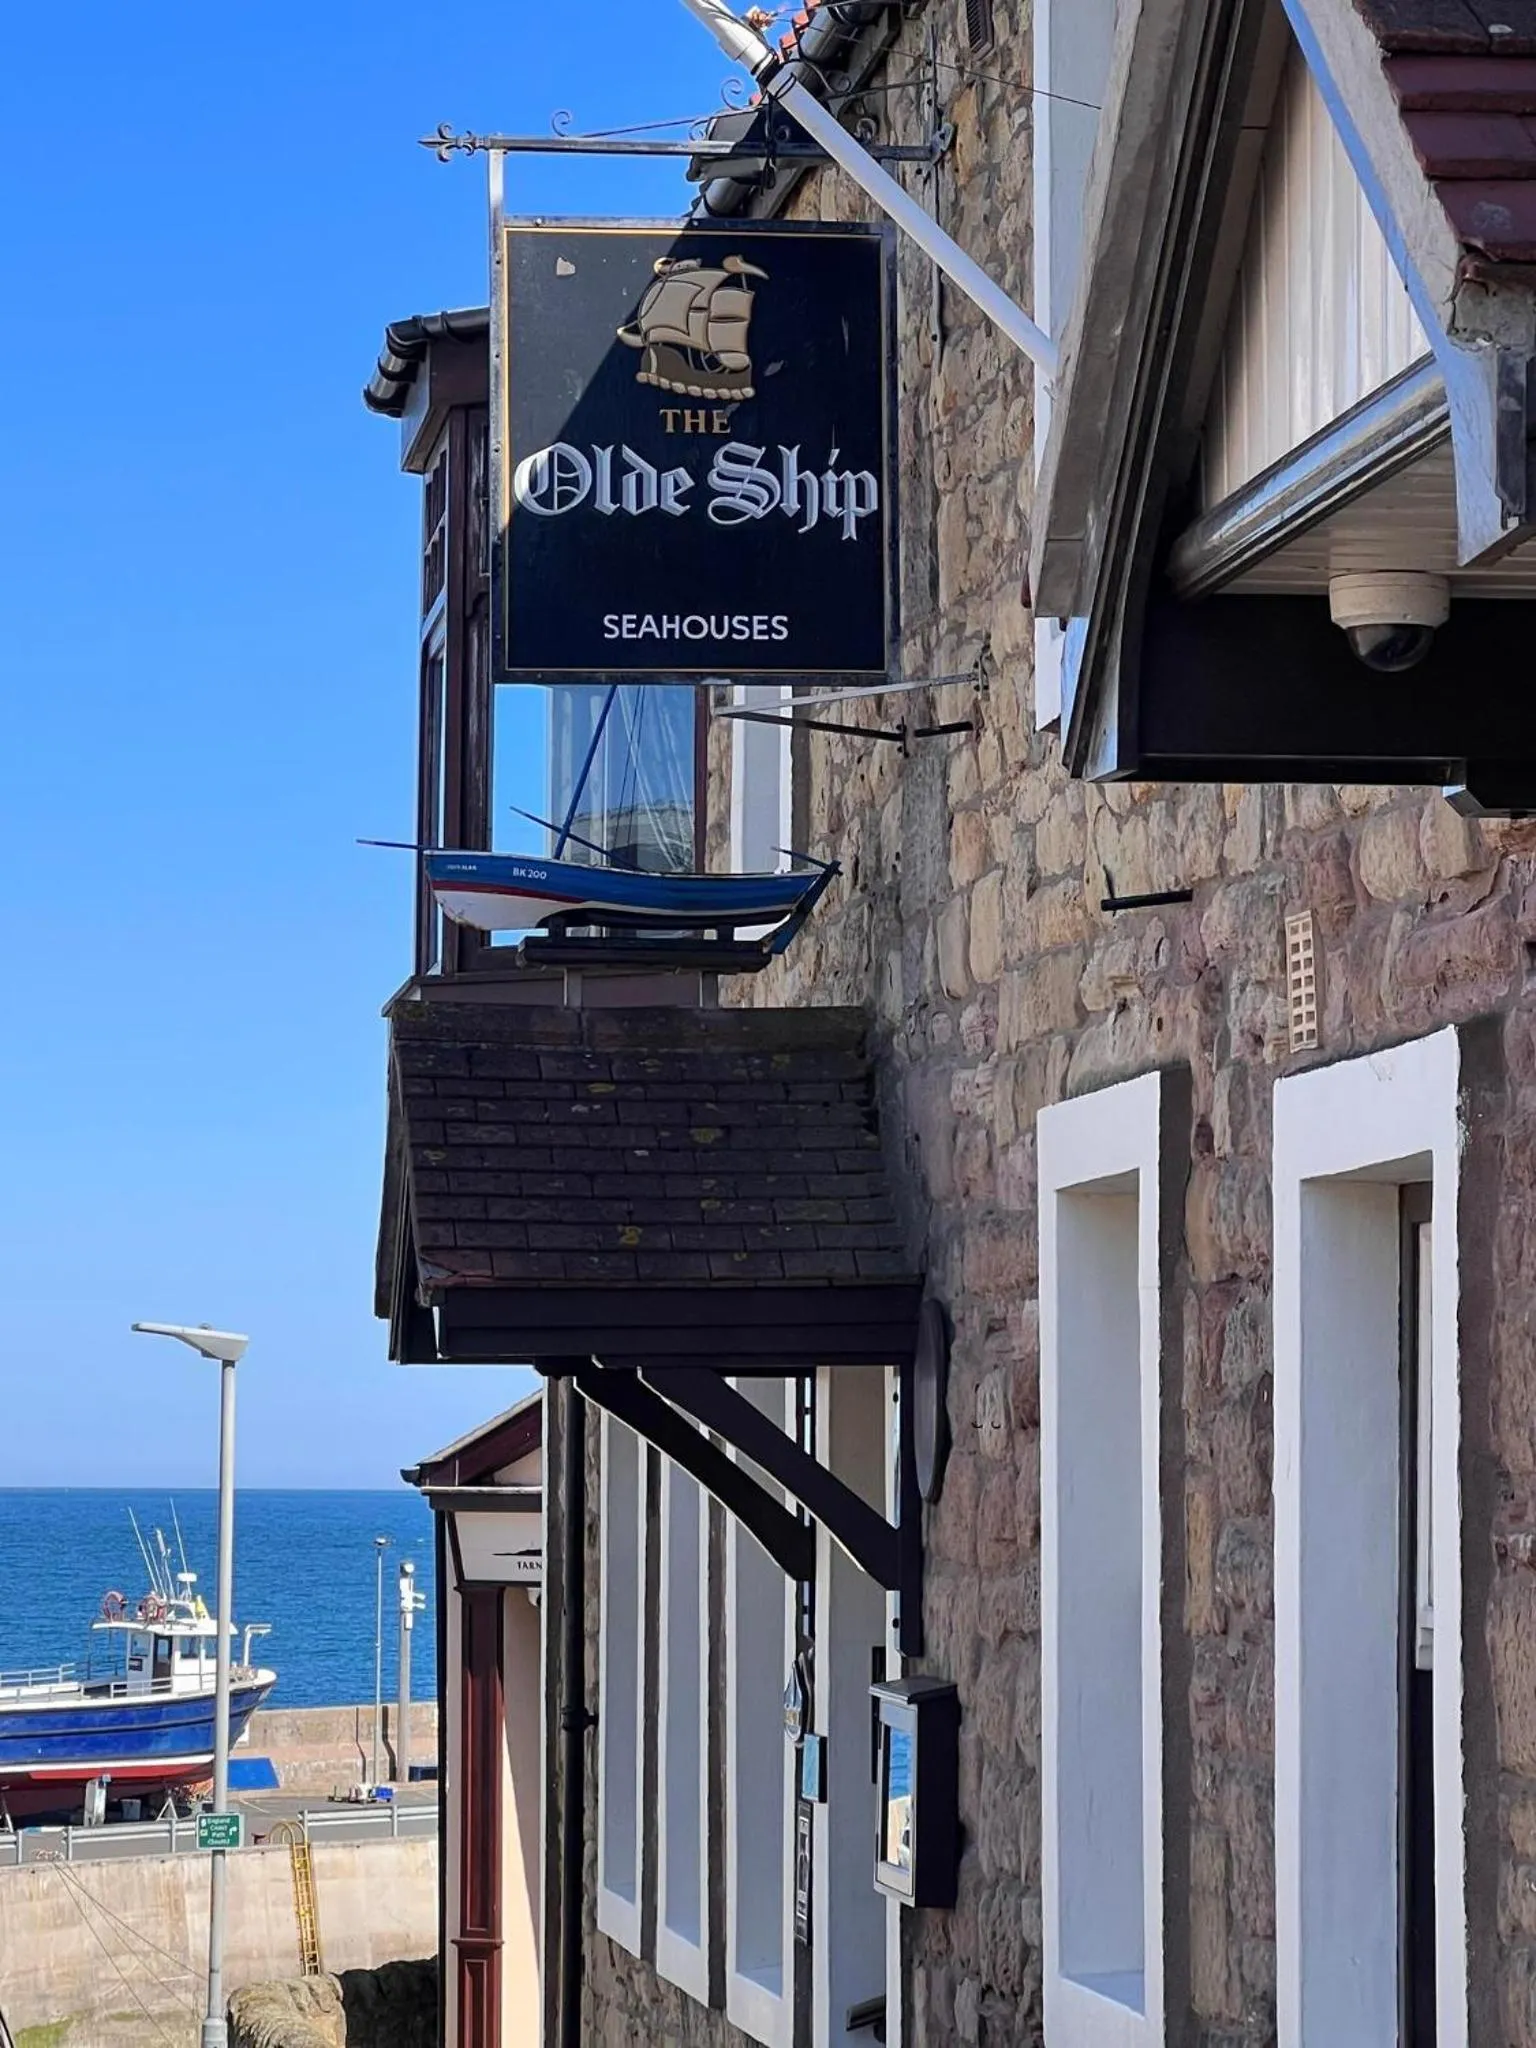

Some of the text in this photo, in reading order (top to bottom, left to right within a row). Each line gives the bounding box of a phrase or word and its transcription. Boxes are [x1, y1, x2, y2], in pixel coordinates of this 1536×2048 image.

[658, 408, 731, 434] THE
[513, 441, 879, 541] Olde Ship
[602, 613, 790, 641] SEAHOUSES
[527, 869, 547, 880] 200
